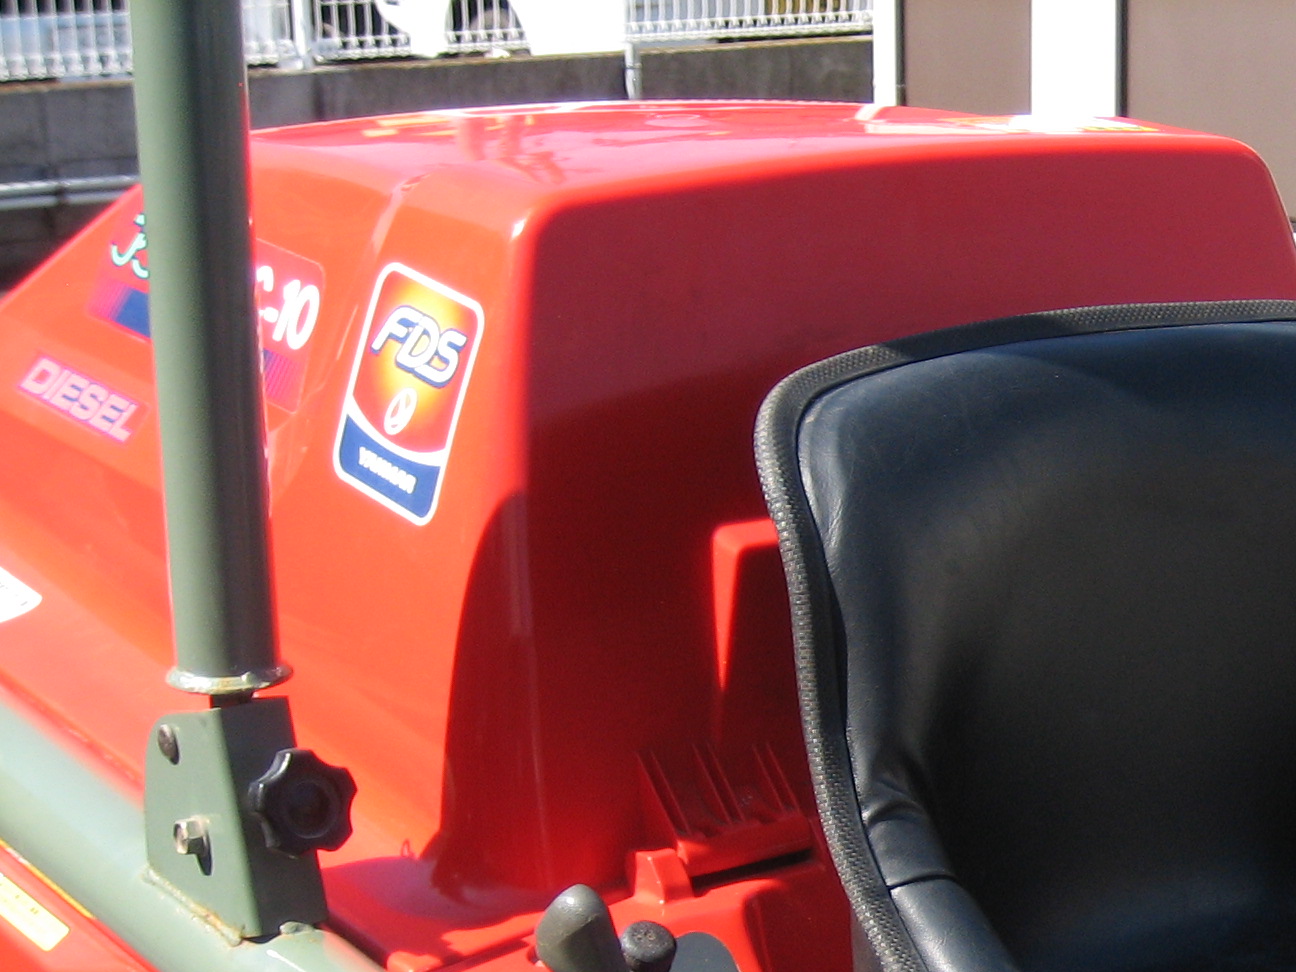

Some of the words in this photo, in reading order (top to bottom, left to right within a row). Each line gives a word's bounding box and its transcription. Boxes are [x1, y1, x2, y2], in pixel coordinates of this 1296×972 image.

[371, 304, 468, 388] FDS
[21, 357, 139, 442] DIESEL
[357, 446, 417, 494] YANMAR
